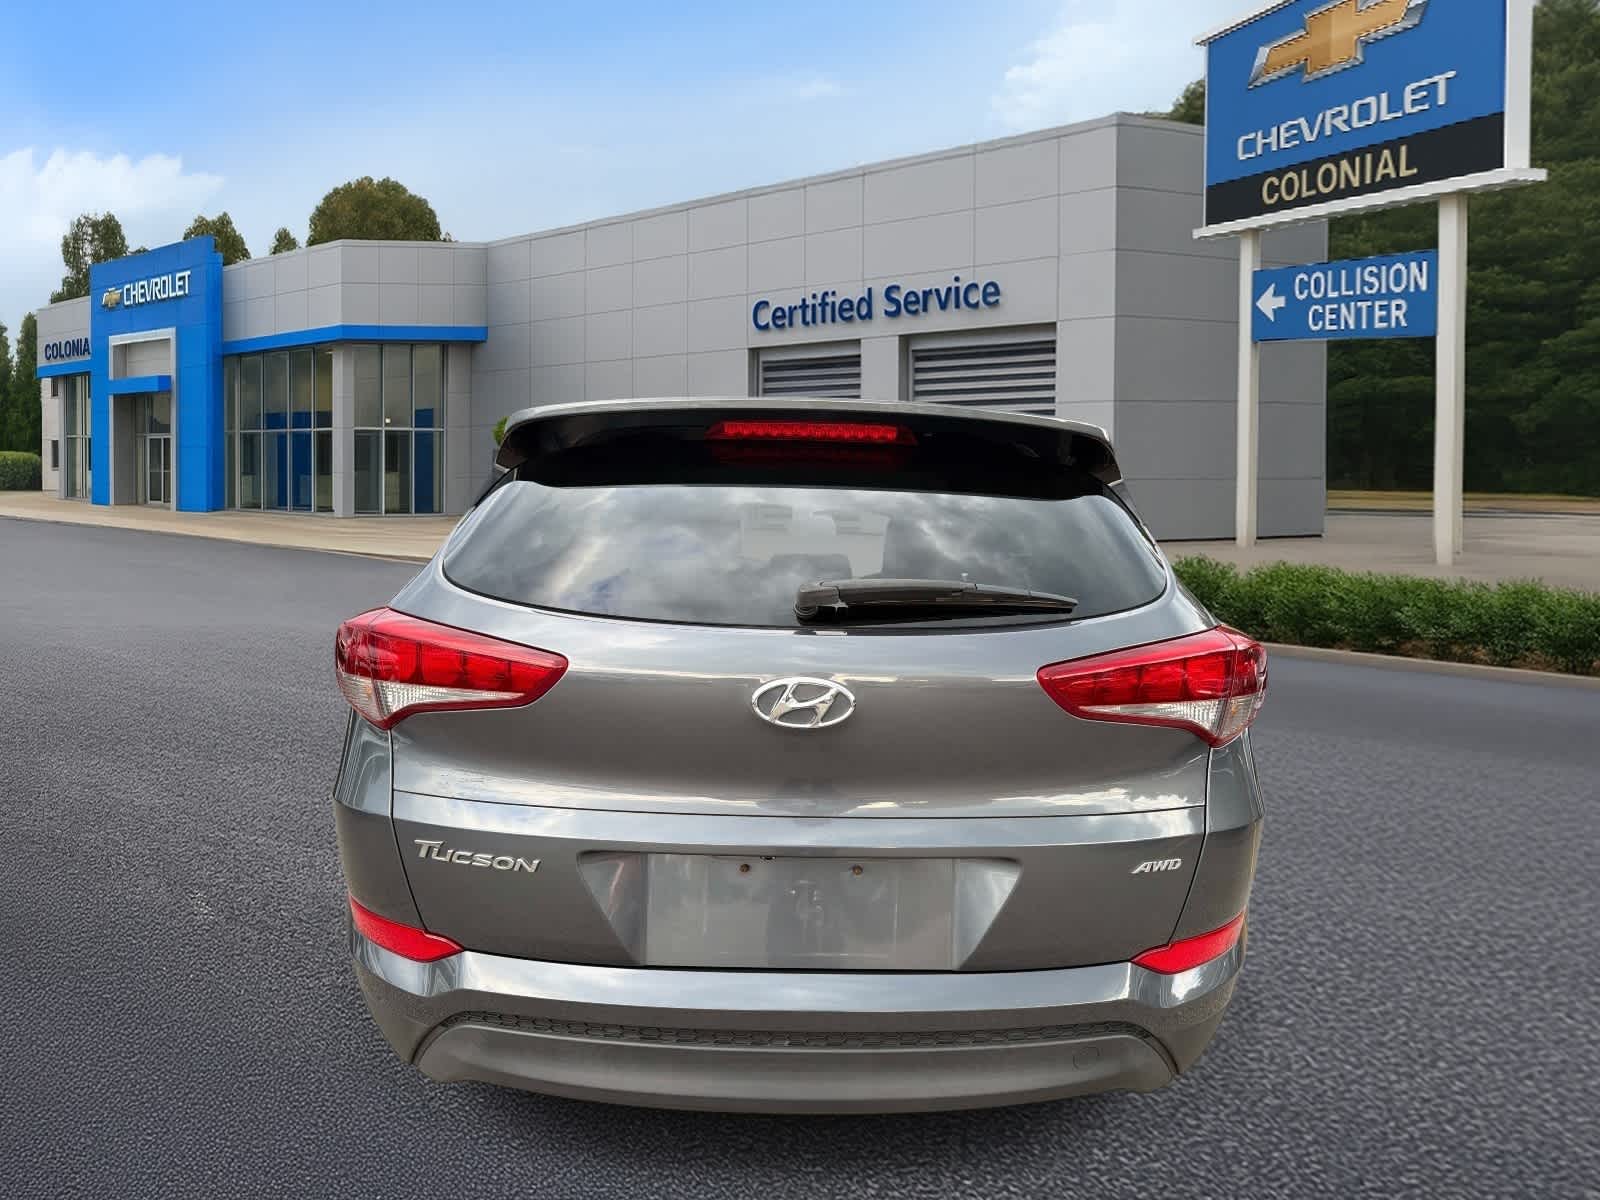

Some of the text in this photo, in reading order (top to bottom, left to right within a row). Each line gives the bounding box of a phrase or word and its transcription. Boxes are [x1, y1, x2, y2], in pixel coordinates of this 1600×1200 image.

[1236, 71, 1457, 161] CHEVROLET
[1261, 144, 1418, 205] COLONIAL
[123, 270, 191, 306] CHEVROLET
[1294, 261, 1428, 300] COLLISION
[752, 275, 1001, 331] Certified Service
[1308, 299, 1408, 332] CENTER
[414, 839, 542, 873] TUCSON
[1131, 858, 1182, 875] AWD
